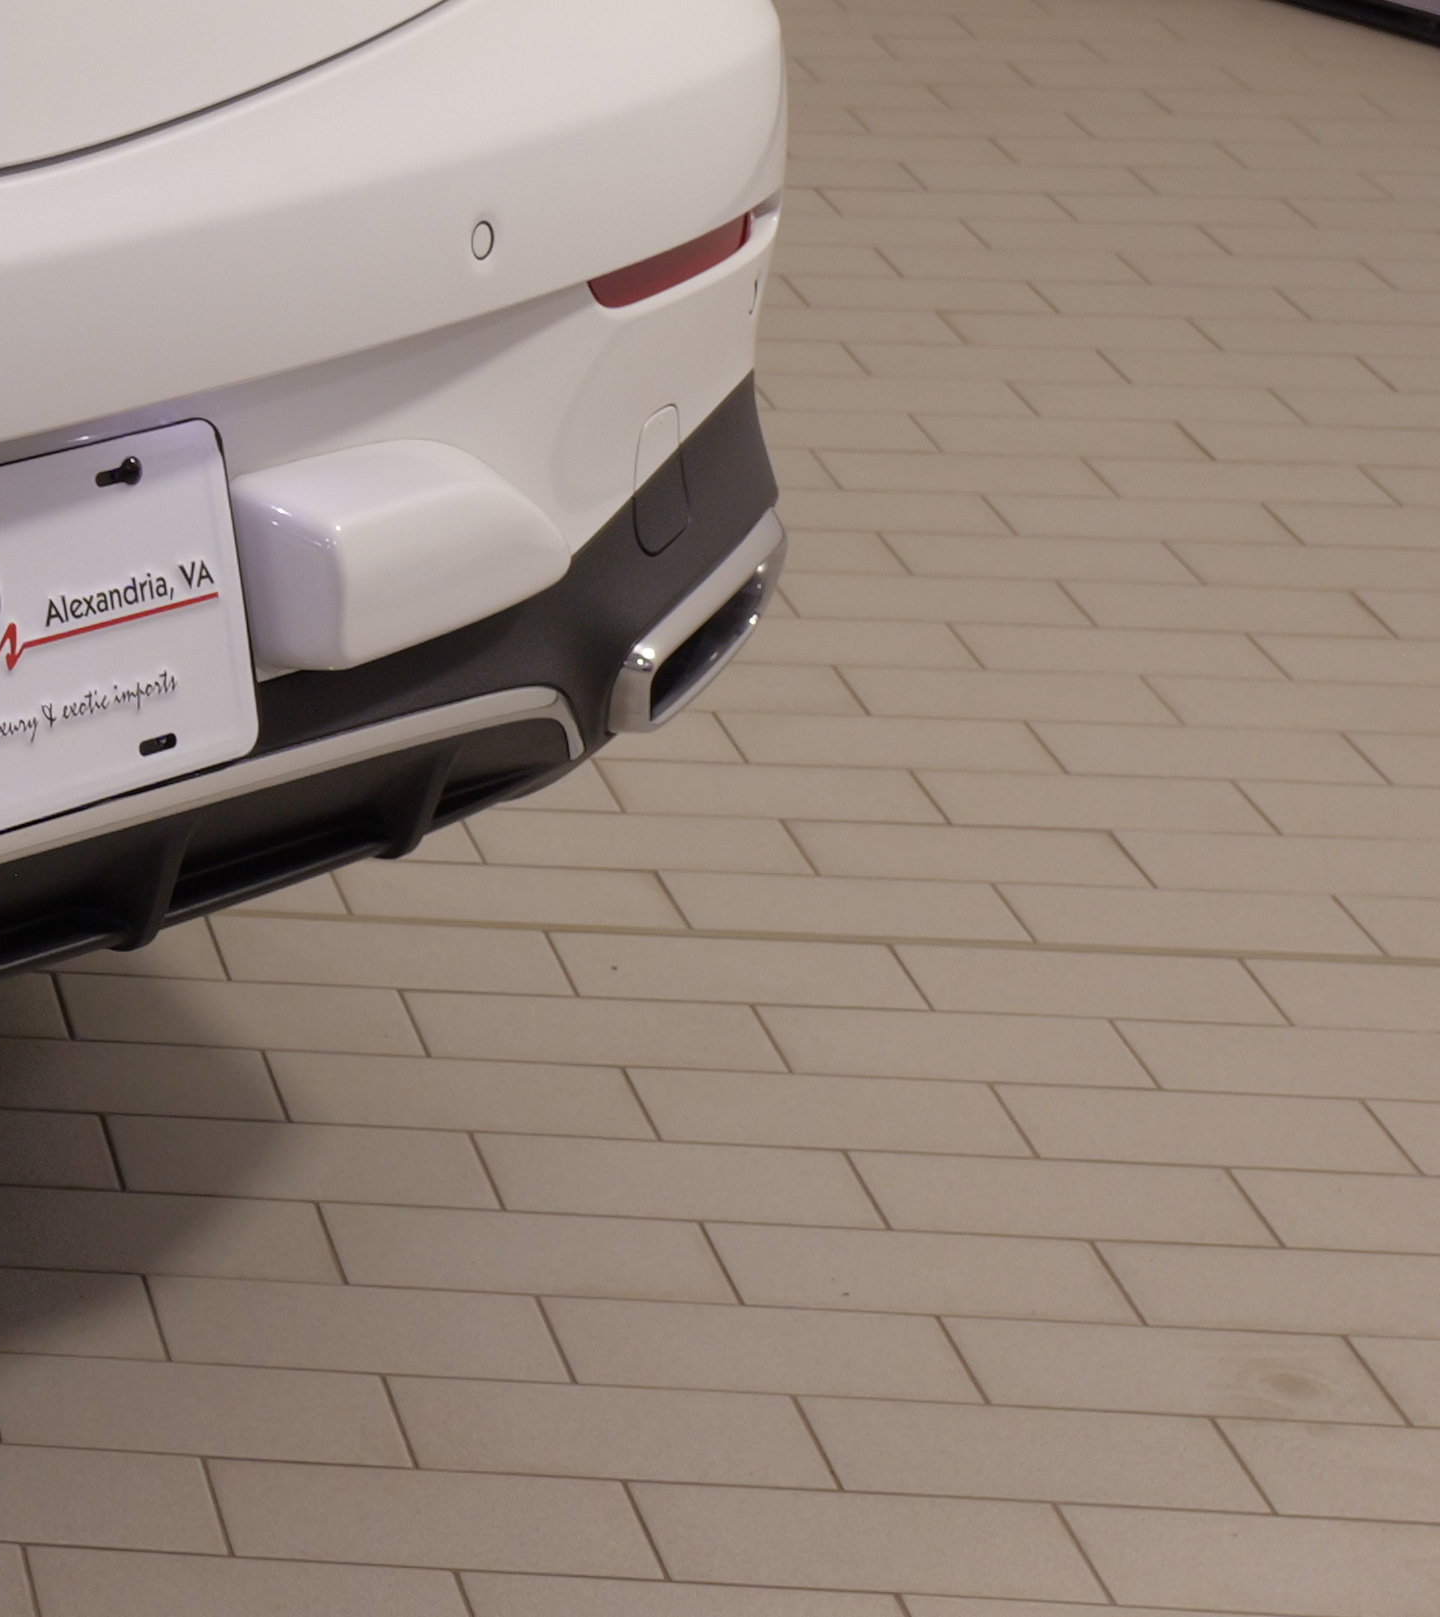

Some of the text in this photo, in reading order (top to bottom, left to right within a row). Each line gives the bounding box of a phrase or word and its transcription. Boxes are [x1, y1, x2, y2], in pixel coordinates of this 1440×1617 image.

[45, 560, 215, 628] Alexandria, VA
[41, 704, 57, 727] &
[62, 692, 110, 719] exotic
[114, 671, 178, 710] imports
